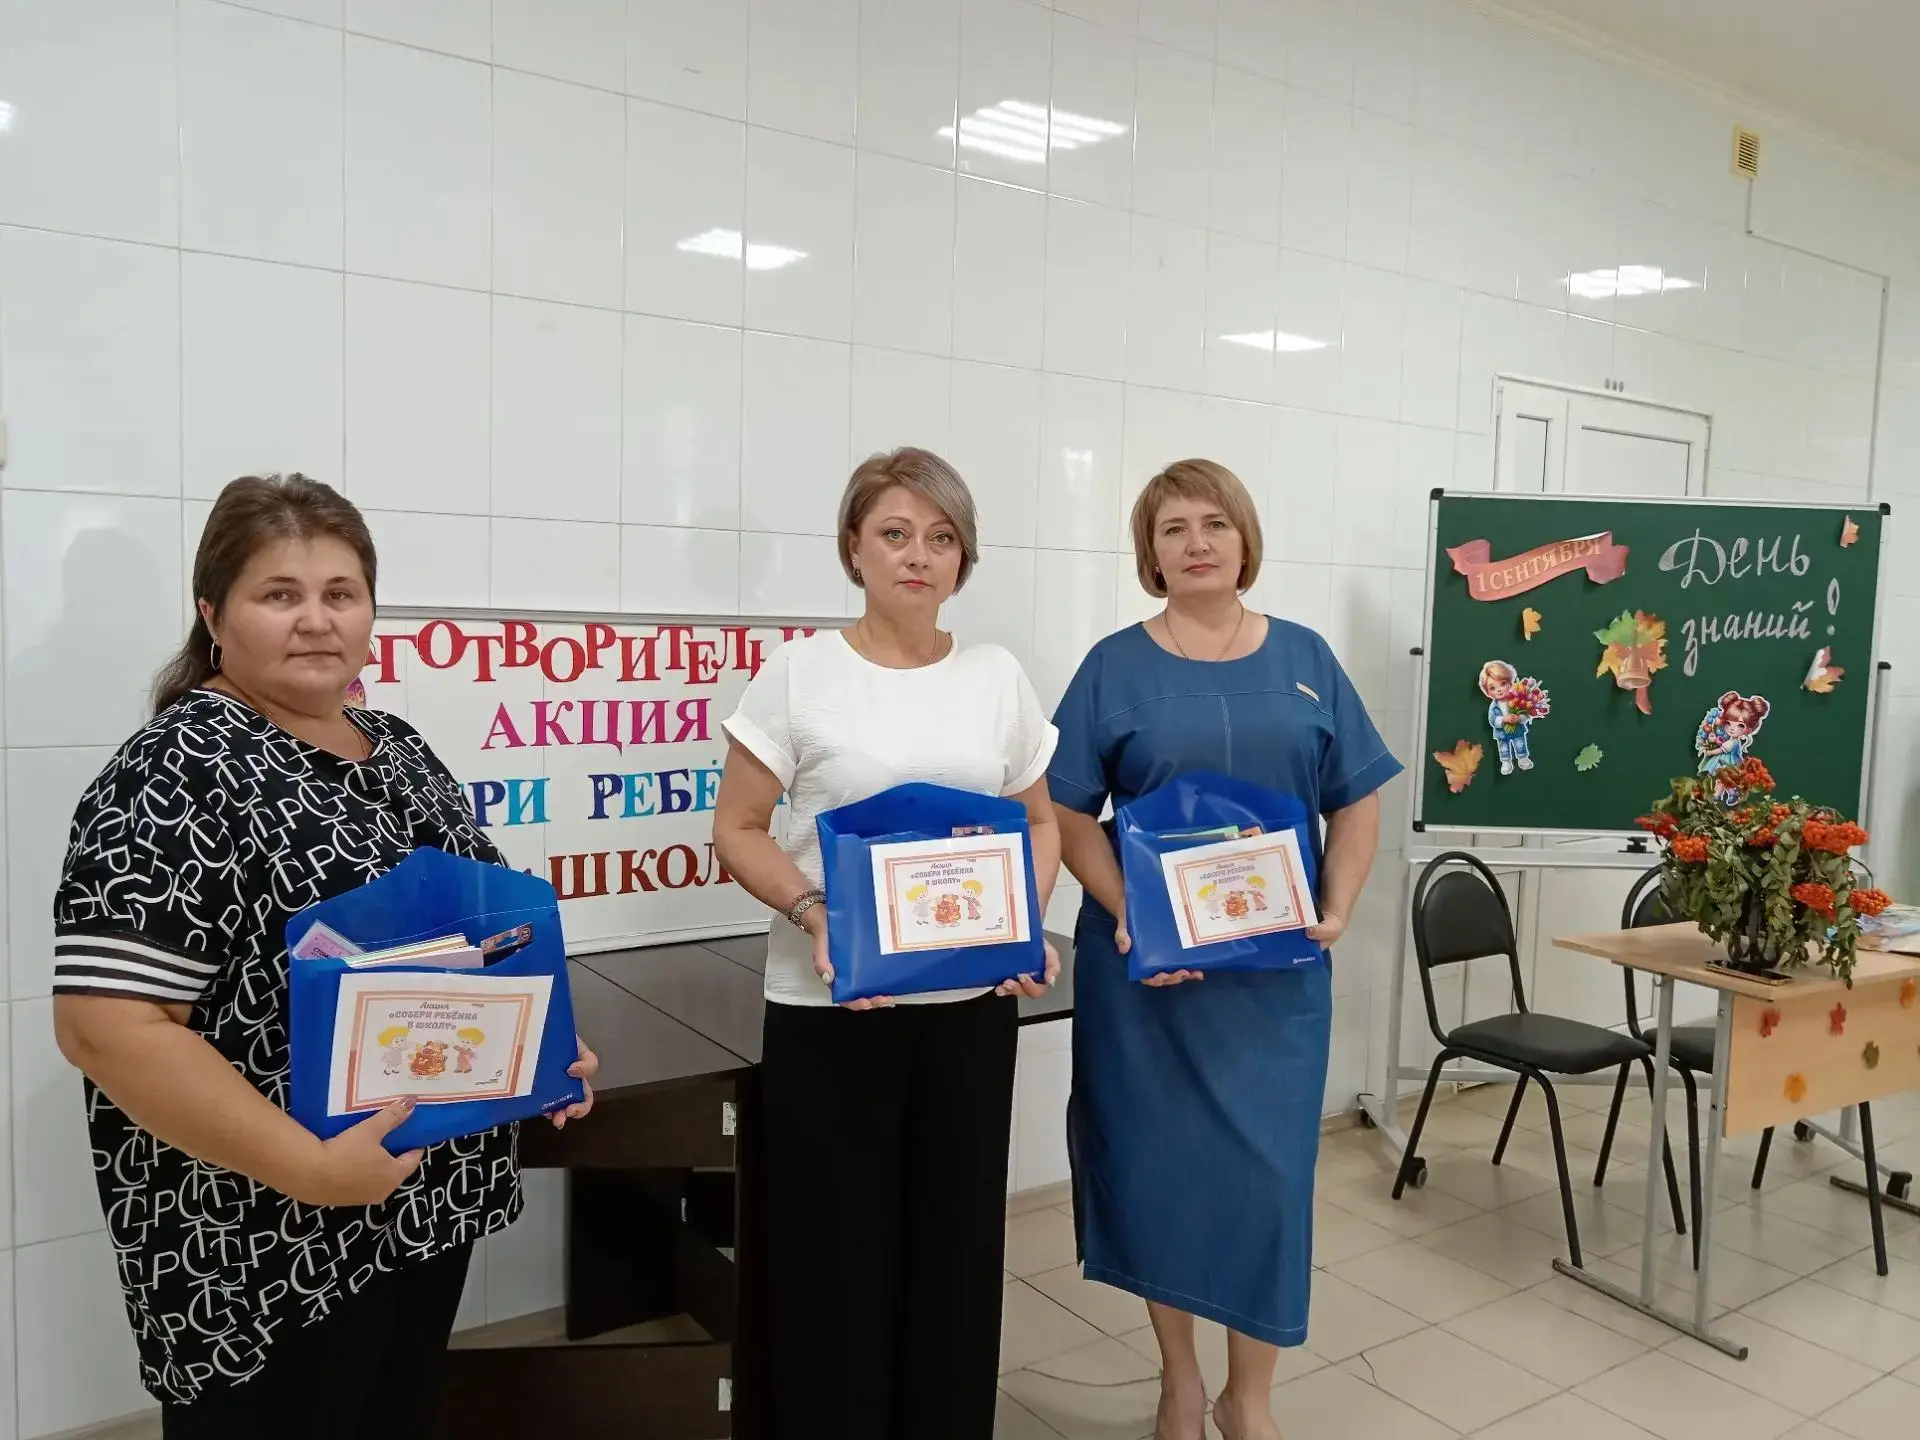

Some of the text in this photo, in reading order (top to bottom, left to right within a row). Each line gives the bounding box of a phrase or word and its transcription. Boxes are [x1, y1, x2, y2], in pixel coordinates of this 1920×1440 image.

[1658, 528, 1811, 589] День
[365, 618, 817, 685] ГОТВОРИТЕЛ
[481, 698, 712, 757] АКЦИЯ
[459, 760, 723, 827] РИ РЕБЁ
[548, 842, 734, 901] ШКОЛ
